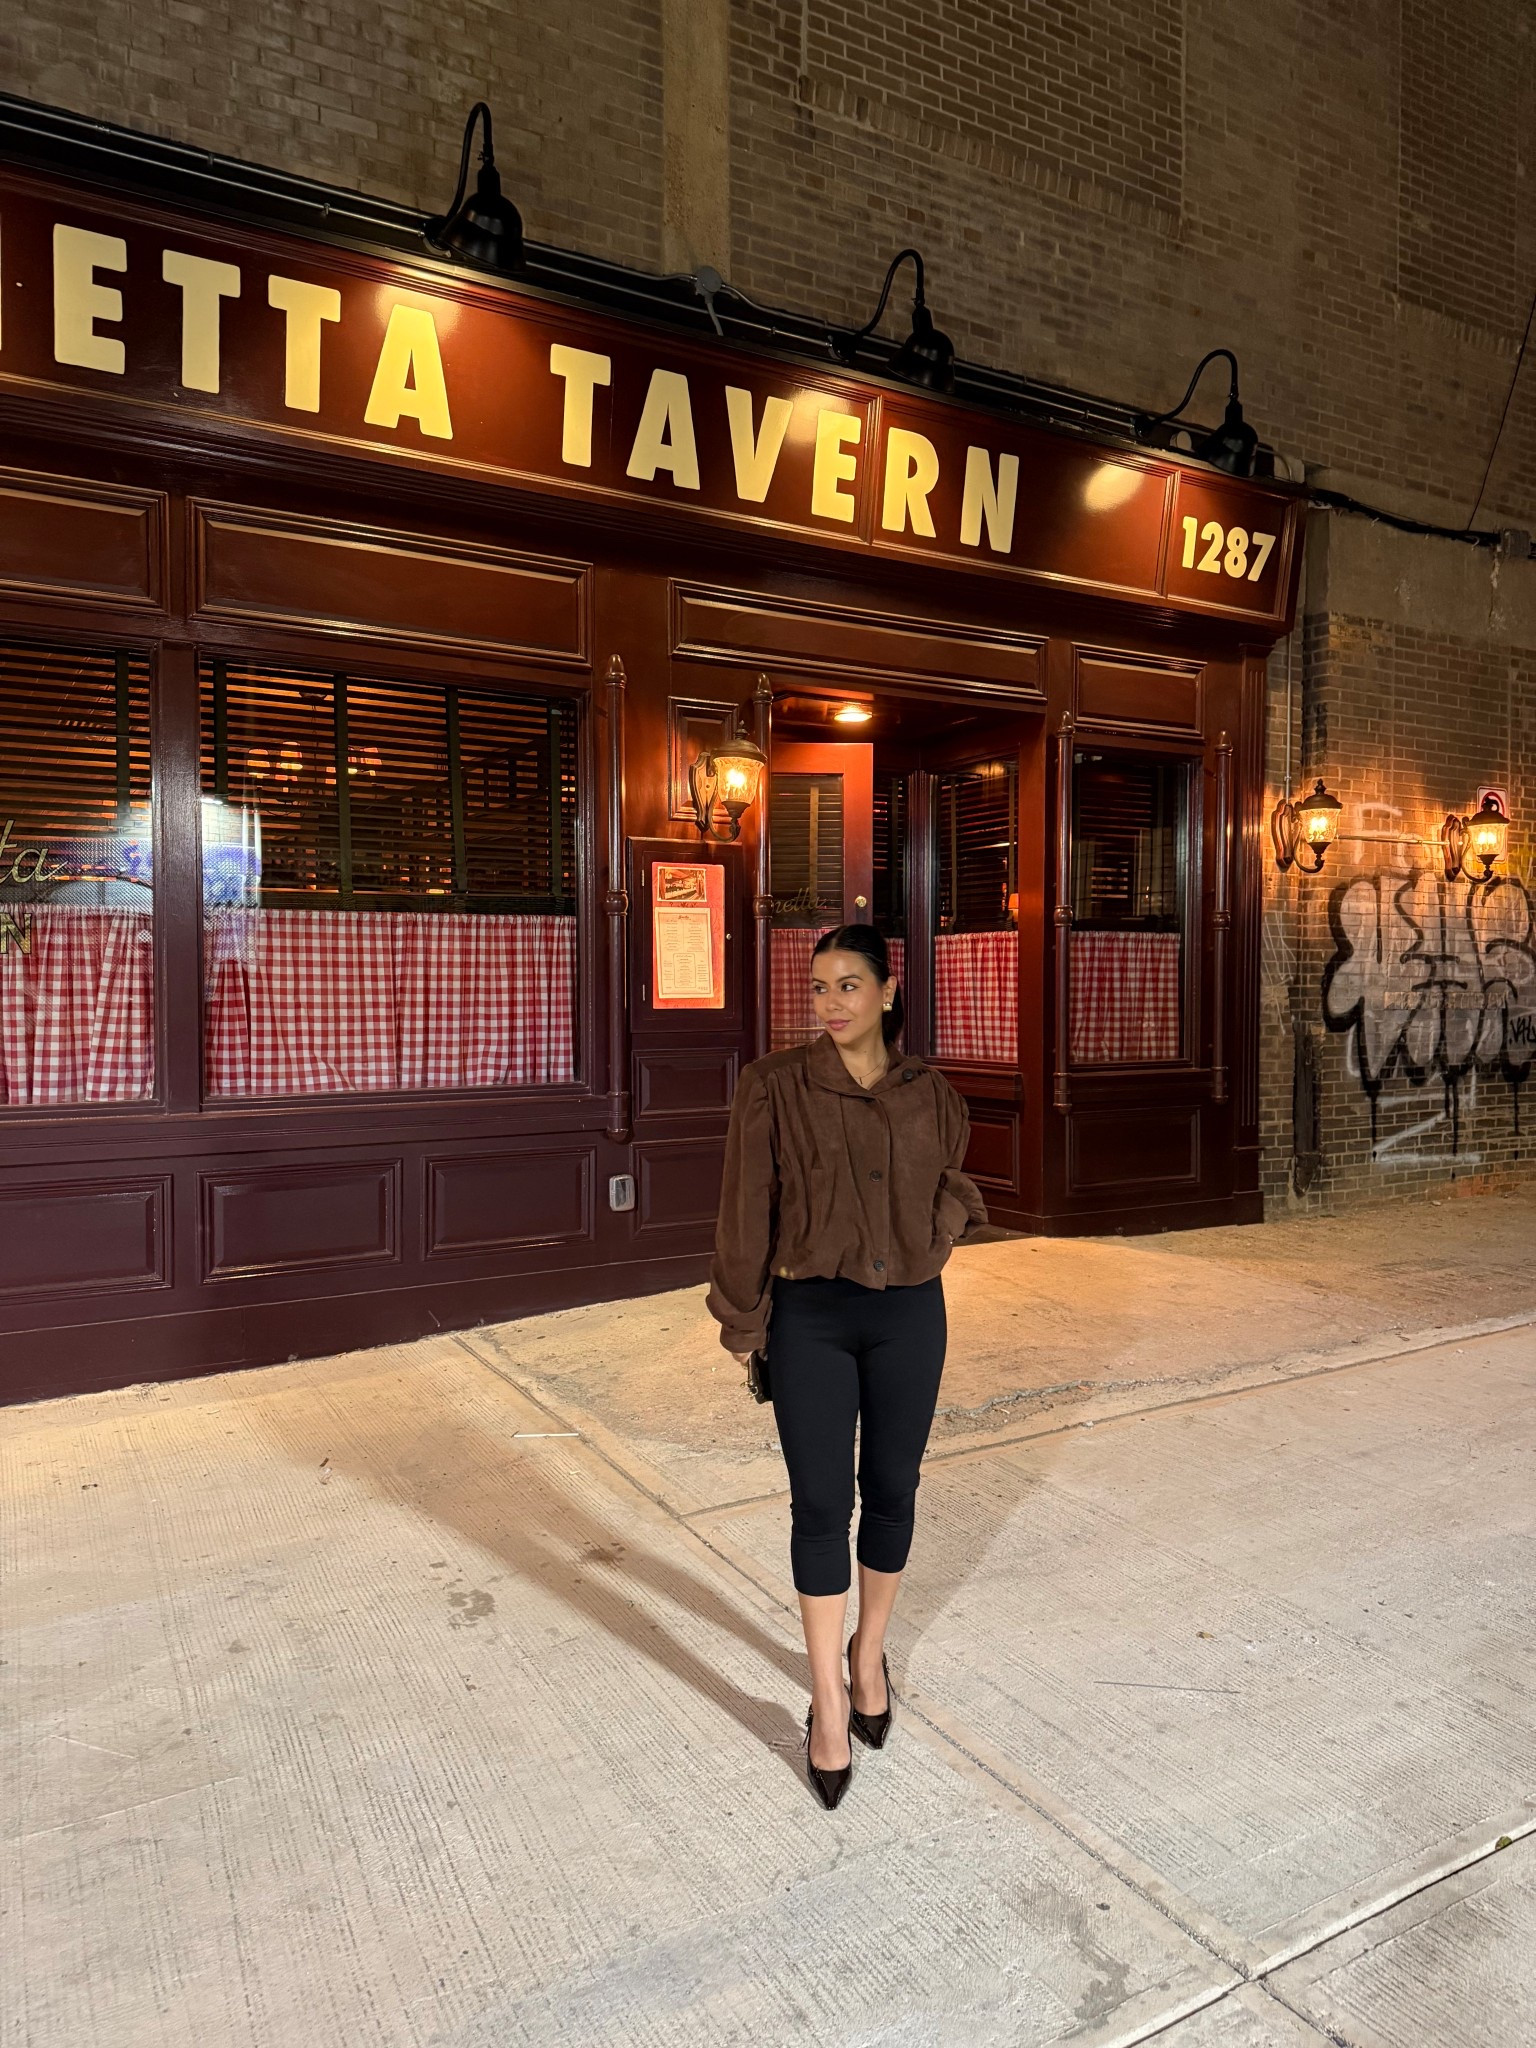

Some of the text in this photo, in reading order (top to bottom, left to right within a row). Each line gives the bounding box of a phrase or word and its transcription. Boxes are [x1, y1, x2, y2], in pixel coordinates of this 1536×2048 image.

[0, 212, 1020, 554] ETTA TAVERN
[1182, 515, 1276, 582] 1287
